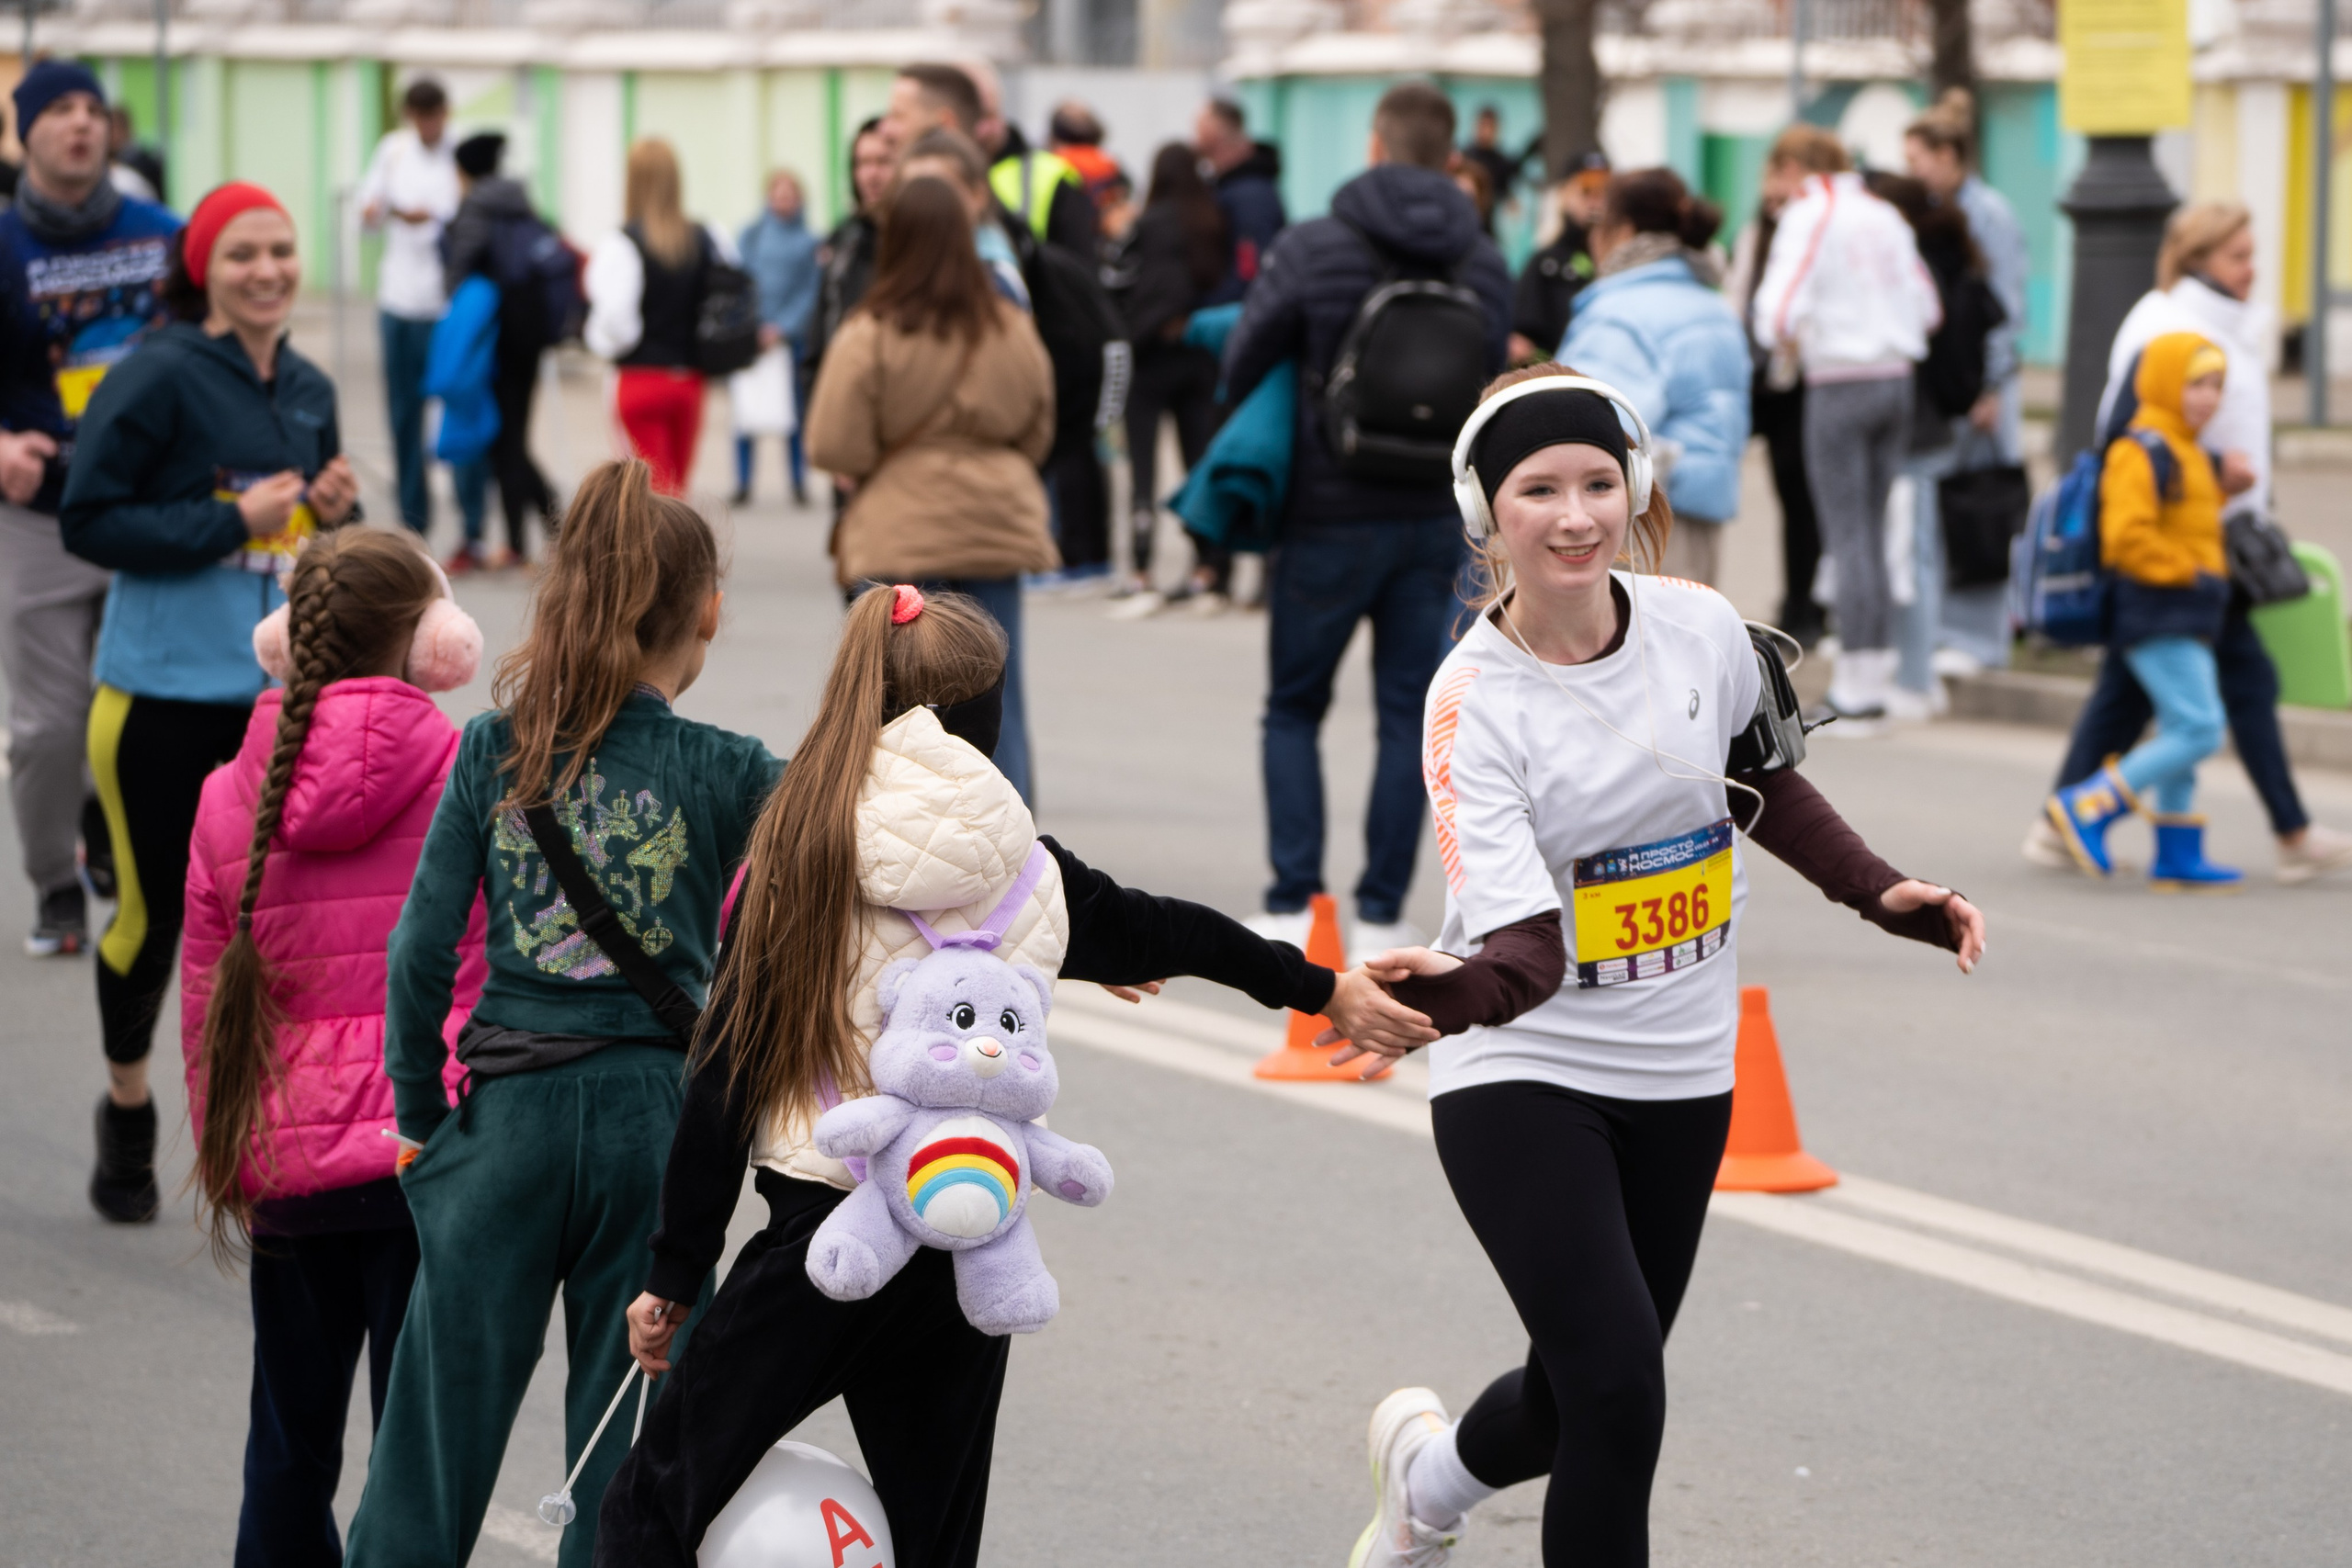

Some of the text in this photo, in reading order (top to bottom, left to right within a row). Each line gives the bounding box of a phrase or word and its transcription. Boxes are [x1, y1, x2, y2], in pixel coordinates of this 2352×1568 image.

[1629, 849, 1694, 873] КОСМОС
[1641, 840, 1694, 861] ПРОСТО
[1614, 883, 1710, 950] 3386
